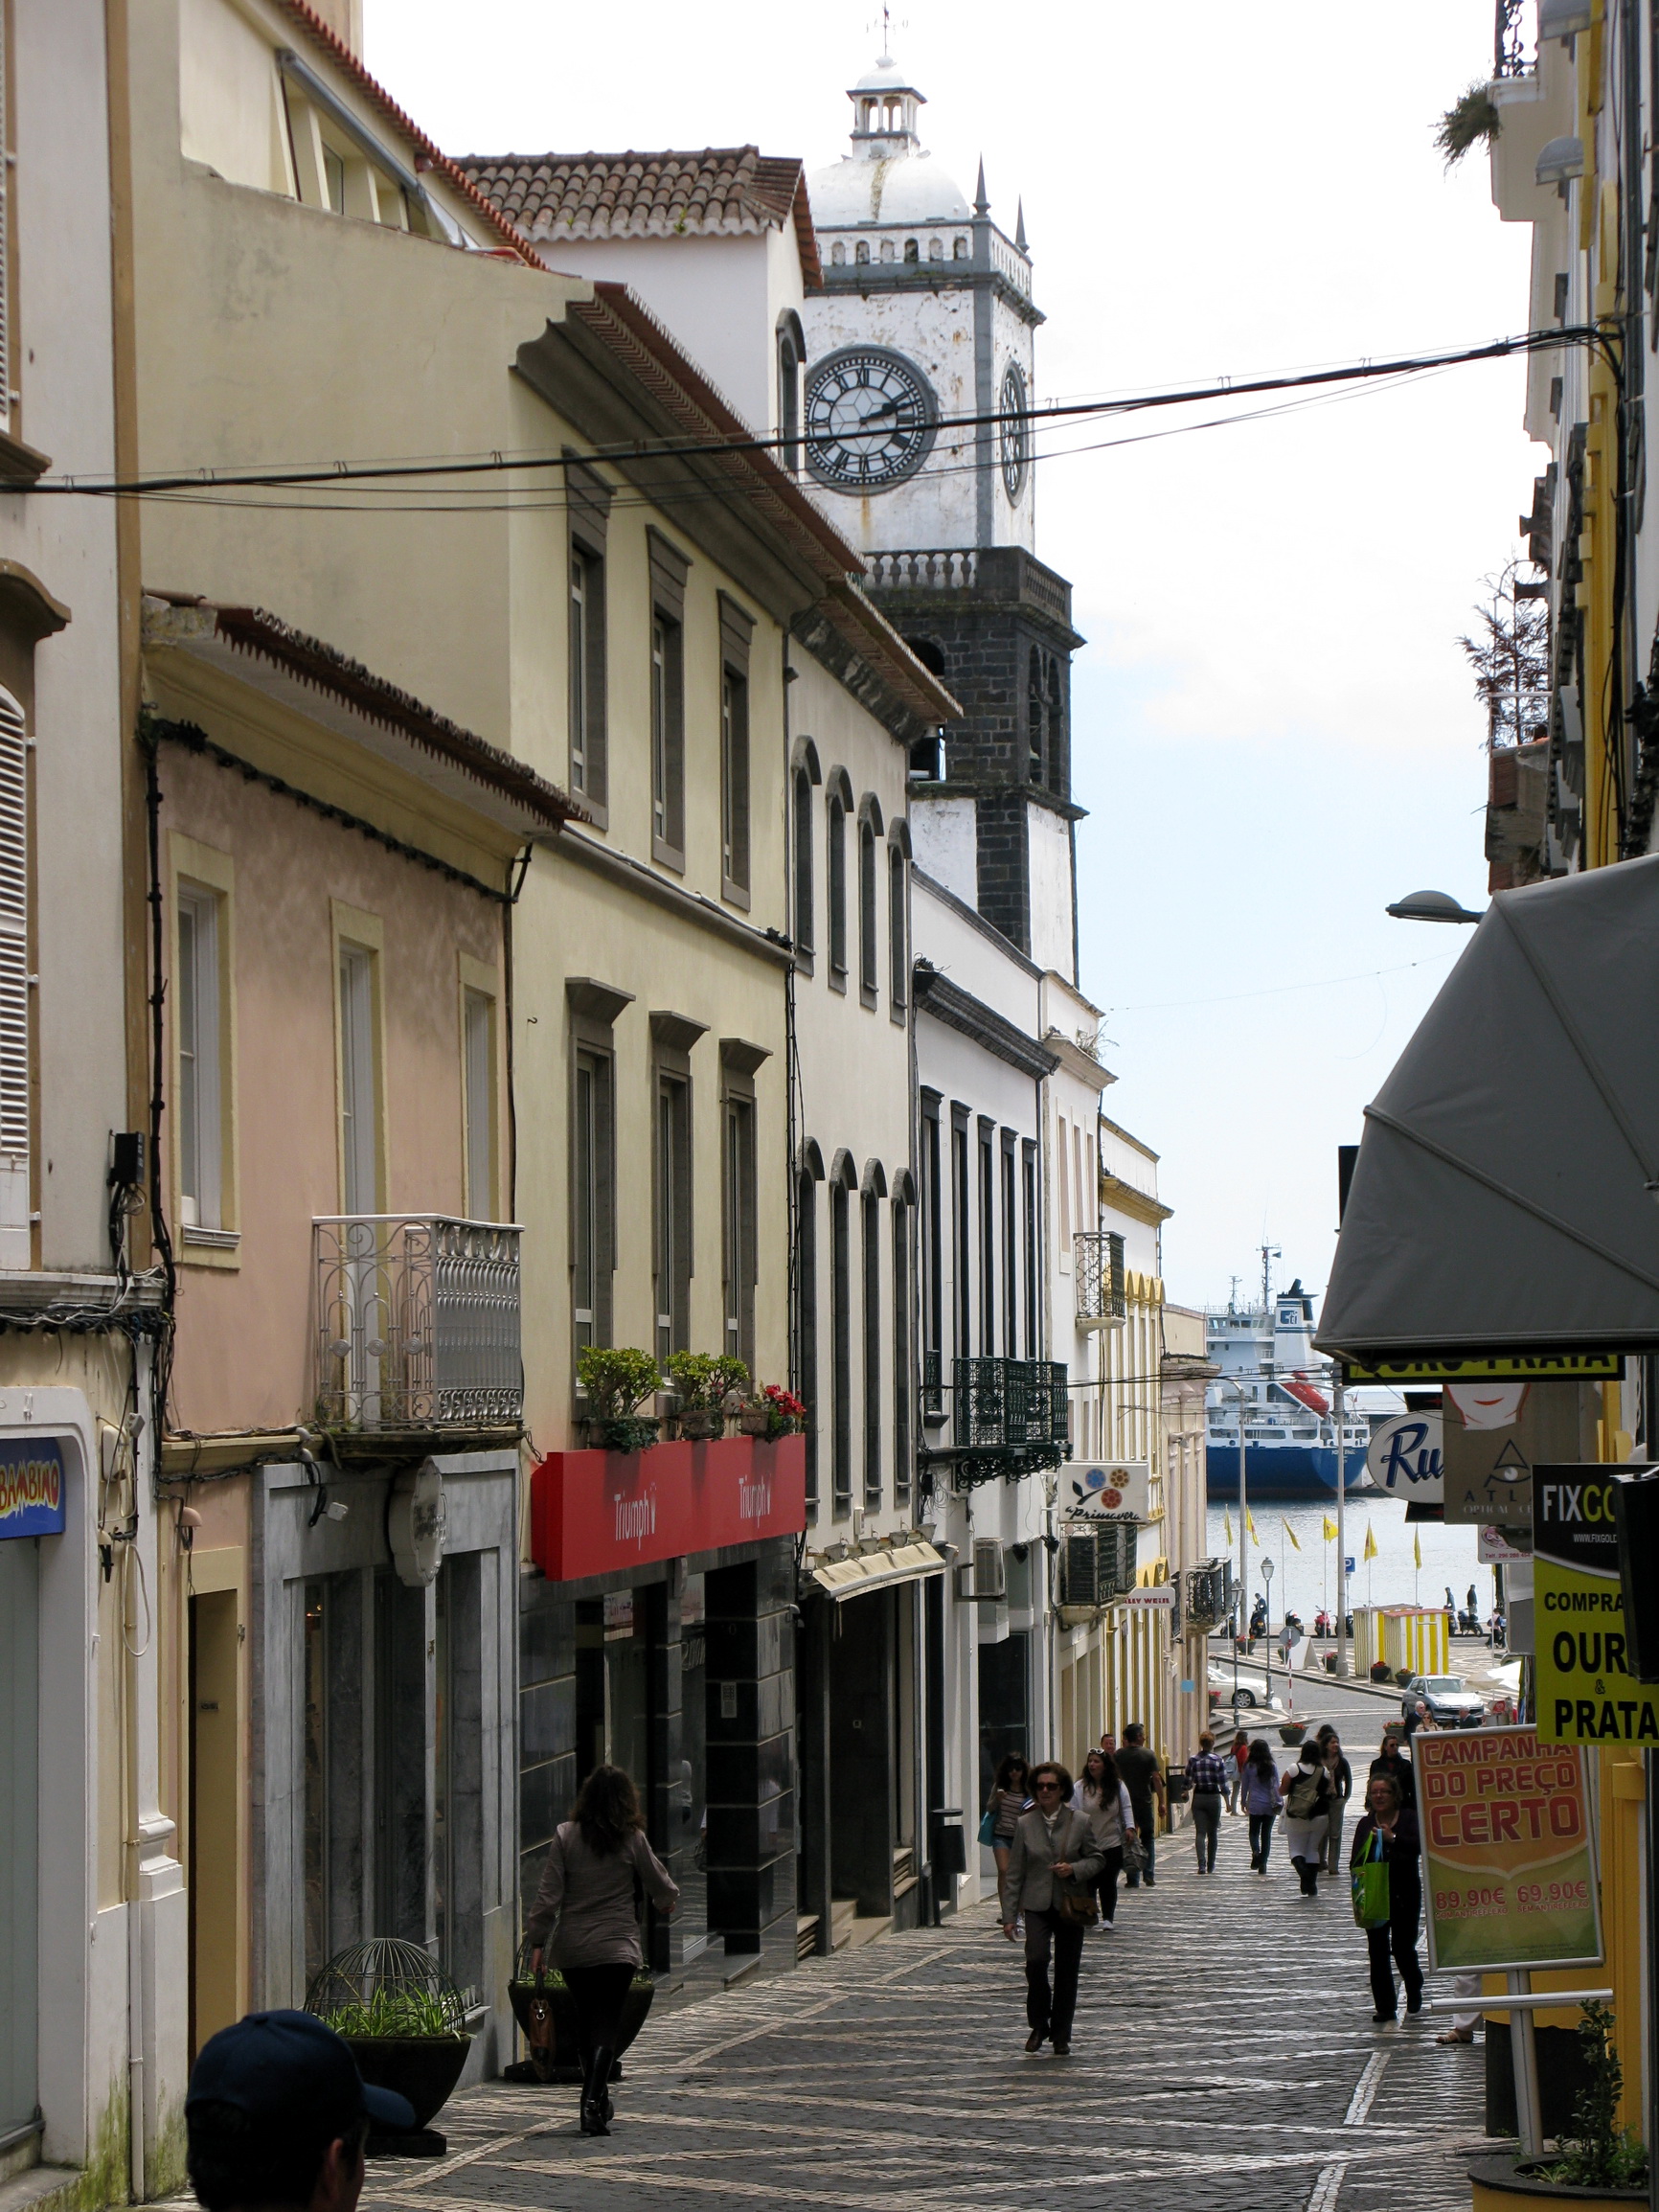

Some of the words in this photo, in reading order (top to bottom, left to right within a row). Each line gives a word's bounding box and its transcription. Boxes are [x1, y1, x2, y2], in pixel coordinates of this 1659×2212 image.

[739, 1475, 766, 1528] Triumph
[1465, 1490, 1532, 1502] ATL
[614, 1489, 649, 1550] Triumph
[1071, 1508, 1142, 1520] Primavera
[1463, 1504, 1509, 1514] OPTICAL
[1553, 1630, 1628, 1674] OUR
[1595, 1678, 1605, 1695] &
[1555, 1699, 1659, 1741] PRATA
[1426, 1770, 1466, 1799] DO
[1476, 1763, 1576, 1795] PREÇO
[1430, 1795, 1580, 1847] CERTO
[1436, 1886, 1506, 1911] 89.90€
[1516, 1881, 1589, 1905] 69.90€
[1454, 1907, 1510, 1919] ANTIREFLEXO
[1516, 1904, 1534, 1913] SEM
[1534, 1901, 1590, 1912] ANTIREFLEXO
